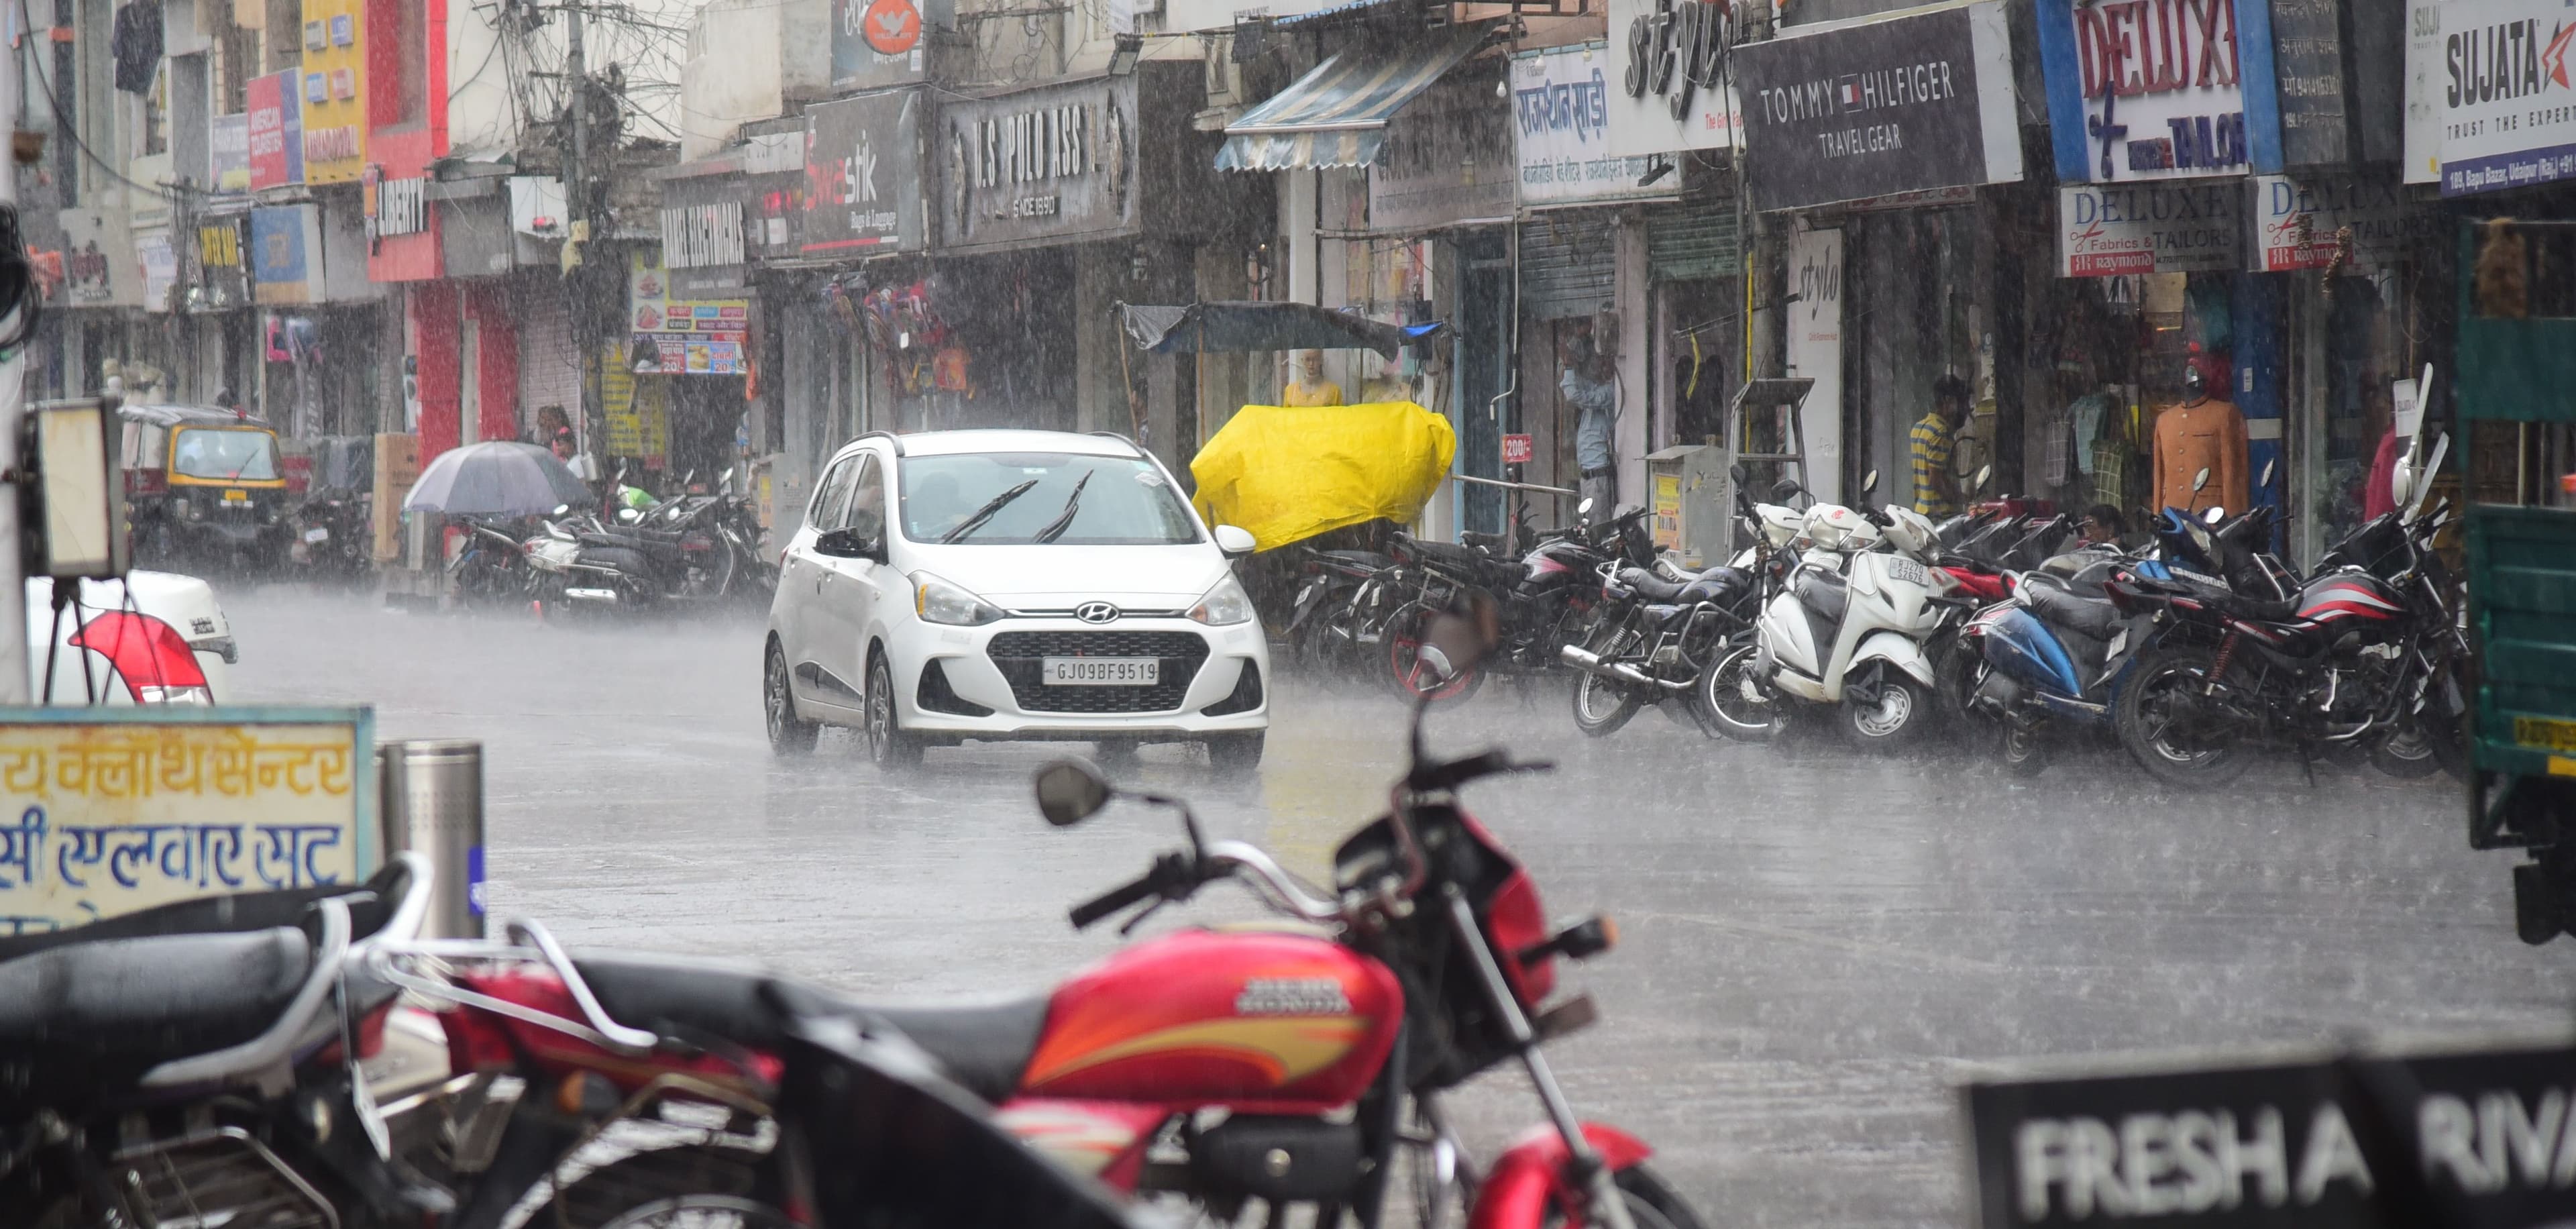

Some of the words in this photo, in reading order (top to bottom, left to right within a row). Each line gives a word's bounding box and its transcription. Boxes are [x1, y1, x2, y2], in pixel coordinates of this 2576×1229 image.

[2447, 19, 2540, 109] SUJATA
[1760, 78, 1833, 125] TOMMY
[1863, 60, 1955, 110] HILFIGER
[1007, 109, 1044, 184] POLO
[1819, 127, 1866, 160] TRAVEL
[1868, 123, 1902, 152] GEAR
[2448, 120, 2484, 140] TRUST
[2496, 115, 2518, 132] THE
[2466, 169, 2485, 191] Bapu
[2509, 161, 2538, 184] Udaipur
[378, 176, 425, 236] LIBERTY
[851, 211, 865, 233] Bags
[2075, 185, 2229, 225] DELUXE
[688, 200, 745, 268] ELECTRICALS
[2090, 238, 2139, 251] Fabrics
[2144, 236, 2153, 248] &
[2153, 229, 2233, 250] TAILORS
[2288, 230, 2337, 243] Frics
[2096, 254, 2153, 271] Raymond
[1799, 245, 1839, 321] stylo
[1057, 663, 1156, 680] GJ09BF9519
[2017, 1104, 2288, 1222] FRESH
